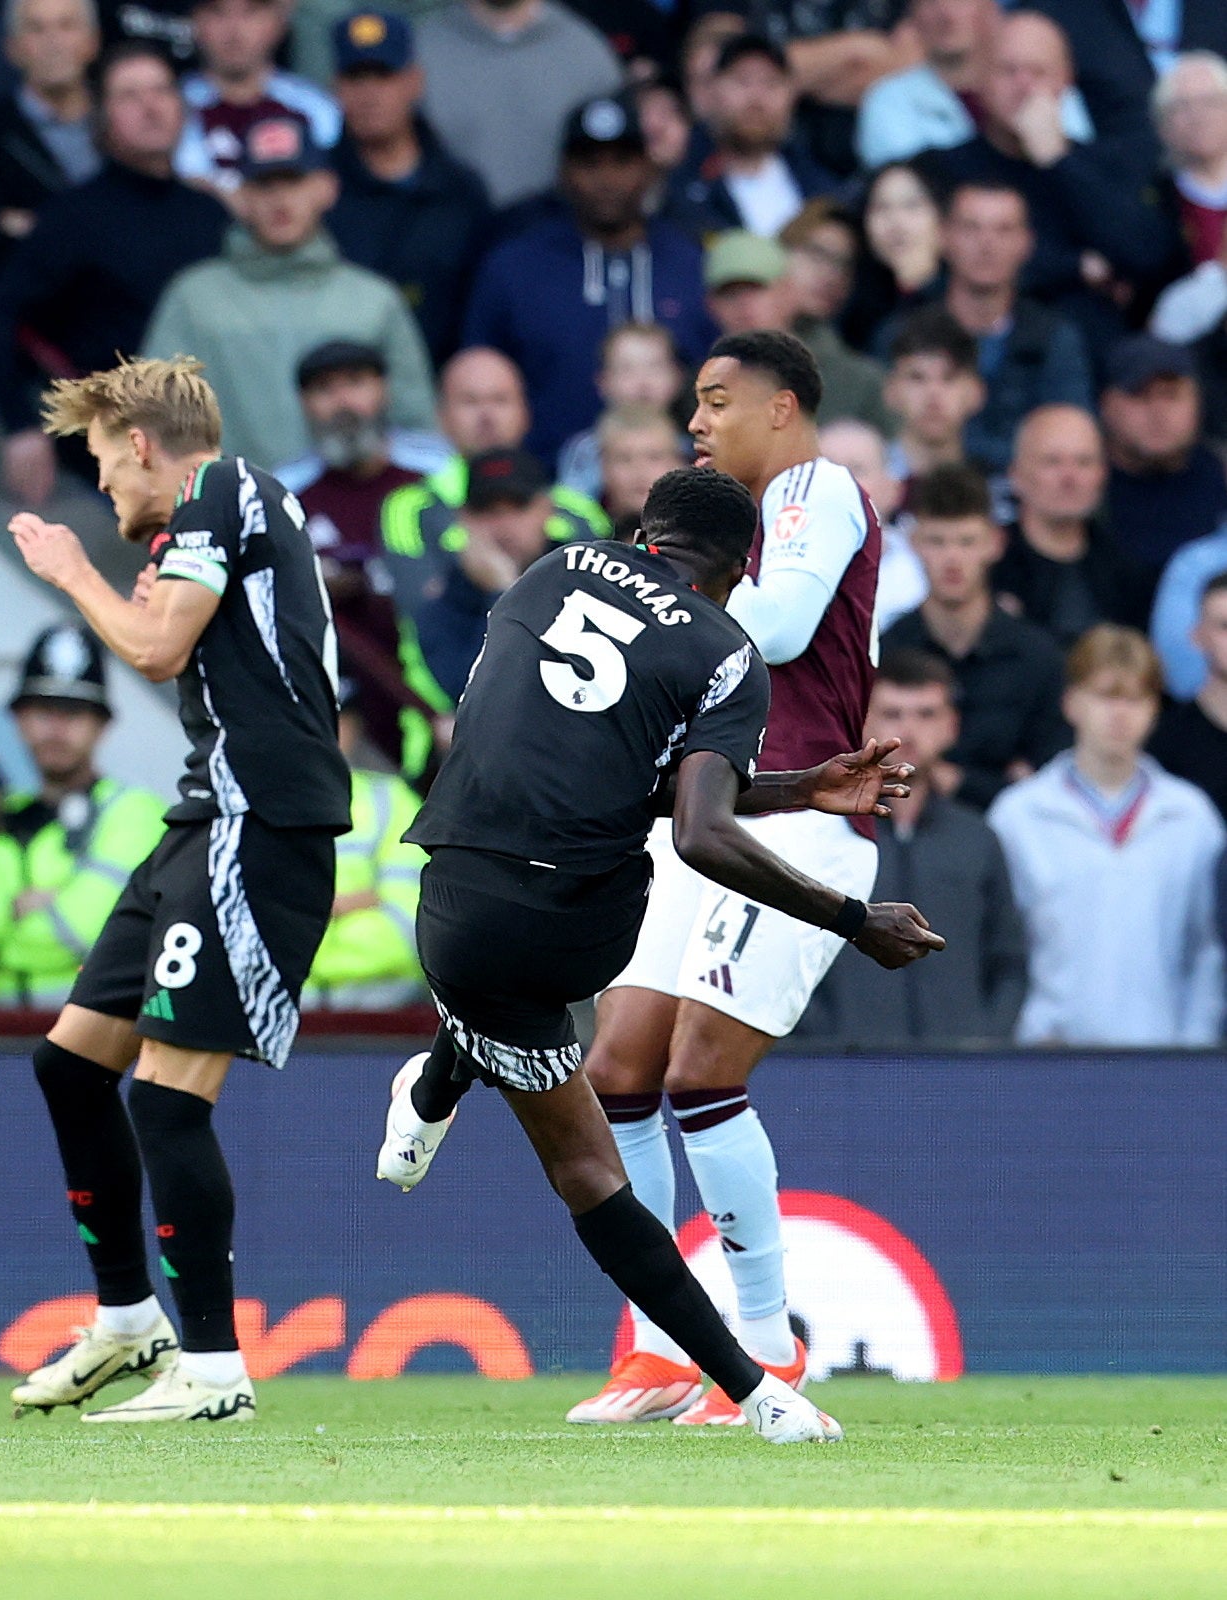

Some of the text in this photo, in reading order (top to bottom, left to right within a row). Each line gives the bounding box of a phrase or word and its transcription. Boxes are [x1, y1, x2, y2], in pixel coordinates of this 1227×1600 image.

[175, 530, 214, 549] VISIT
[563, 545, 692, 626] THOMAS
[539, 588, 647, 713] 5
[154, 922, 203, 989] 8
[703, 893, 761, 962] 41
